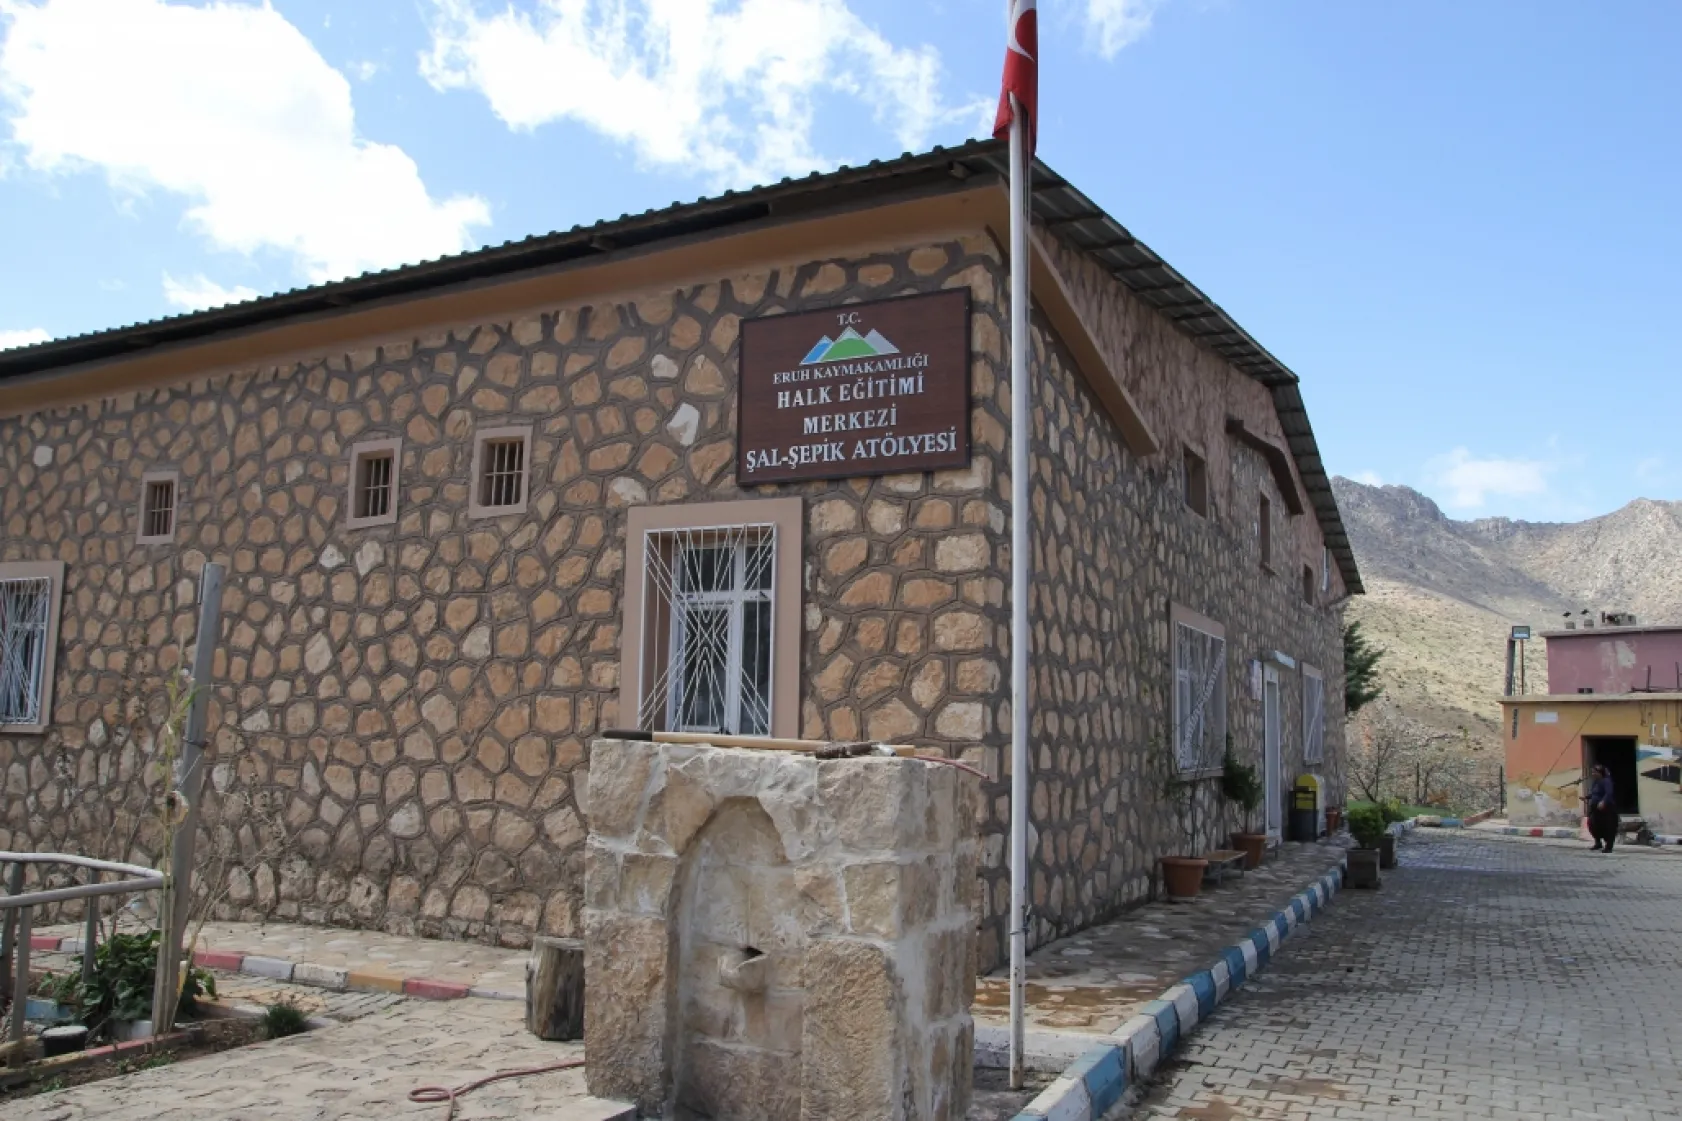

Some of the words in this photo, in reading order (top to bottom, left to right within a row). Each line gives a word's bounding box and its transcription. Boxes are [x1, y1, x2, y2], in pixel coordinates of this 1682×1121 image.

[837, 312, 863, 326] T.C.
[773, 368, 810, 385] ERUH
[813, 353, 929, 379] KAYMAKAMLIĞI
[777, 386, 833, 409] HALK
[839, 371, 925, 402] EĞİTİMİ
[803, 403, 897, 435] MERKEZİ
[746, 437, 845, 473] ŞAL-ŞEPİK
[851, 426, 957, 460] ATÖLYESİ
